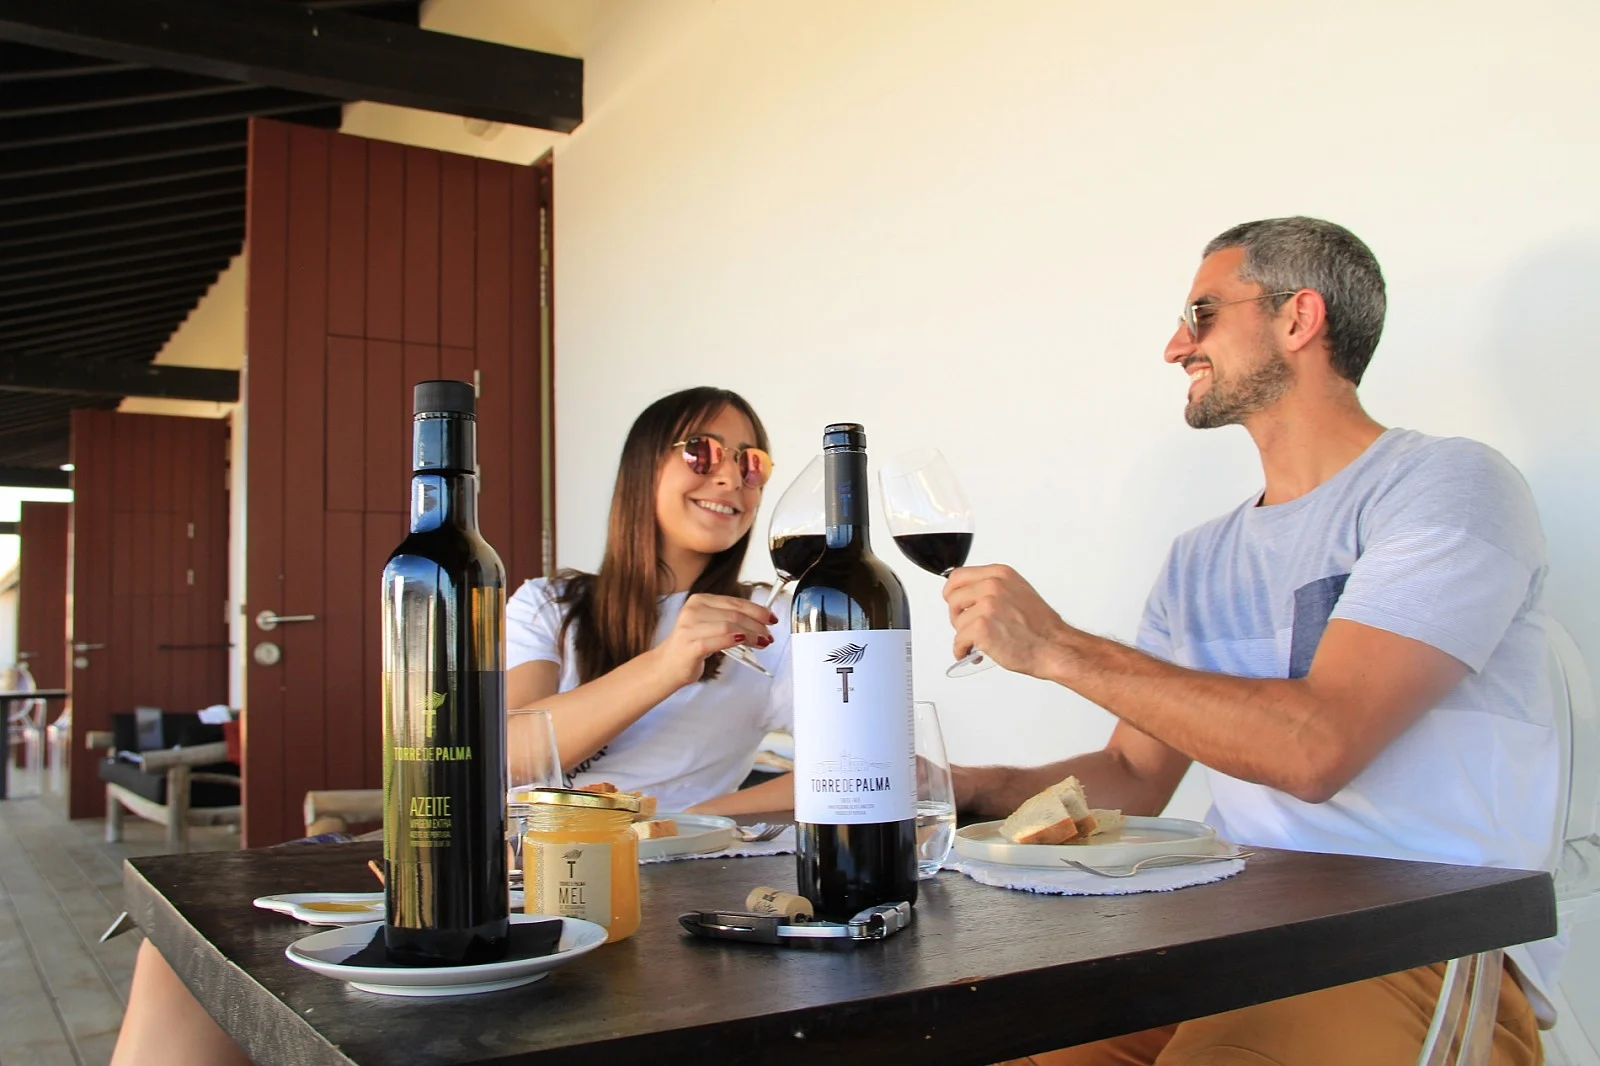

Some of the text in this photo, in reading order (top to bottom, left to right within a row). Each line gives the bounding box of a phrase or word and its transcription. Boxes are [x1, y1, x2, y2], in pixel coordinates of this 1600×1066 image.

[836, 666, 854, 703] T
[393, 746, 472, 761] TORRE DE PALMA
[811, 776, 891, 793] TORRE DE PALMA
[409, 796, 452, 816] AZEITE
[567, 861, 576, 878] T
[559, 887, 587, 905] MEL
